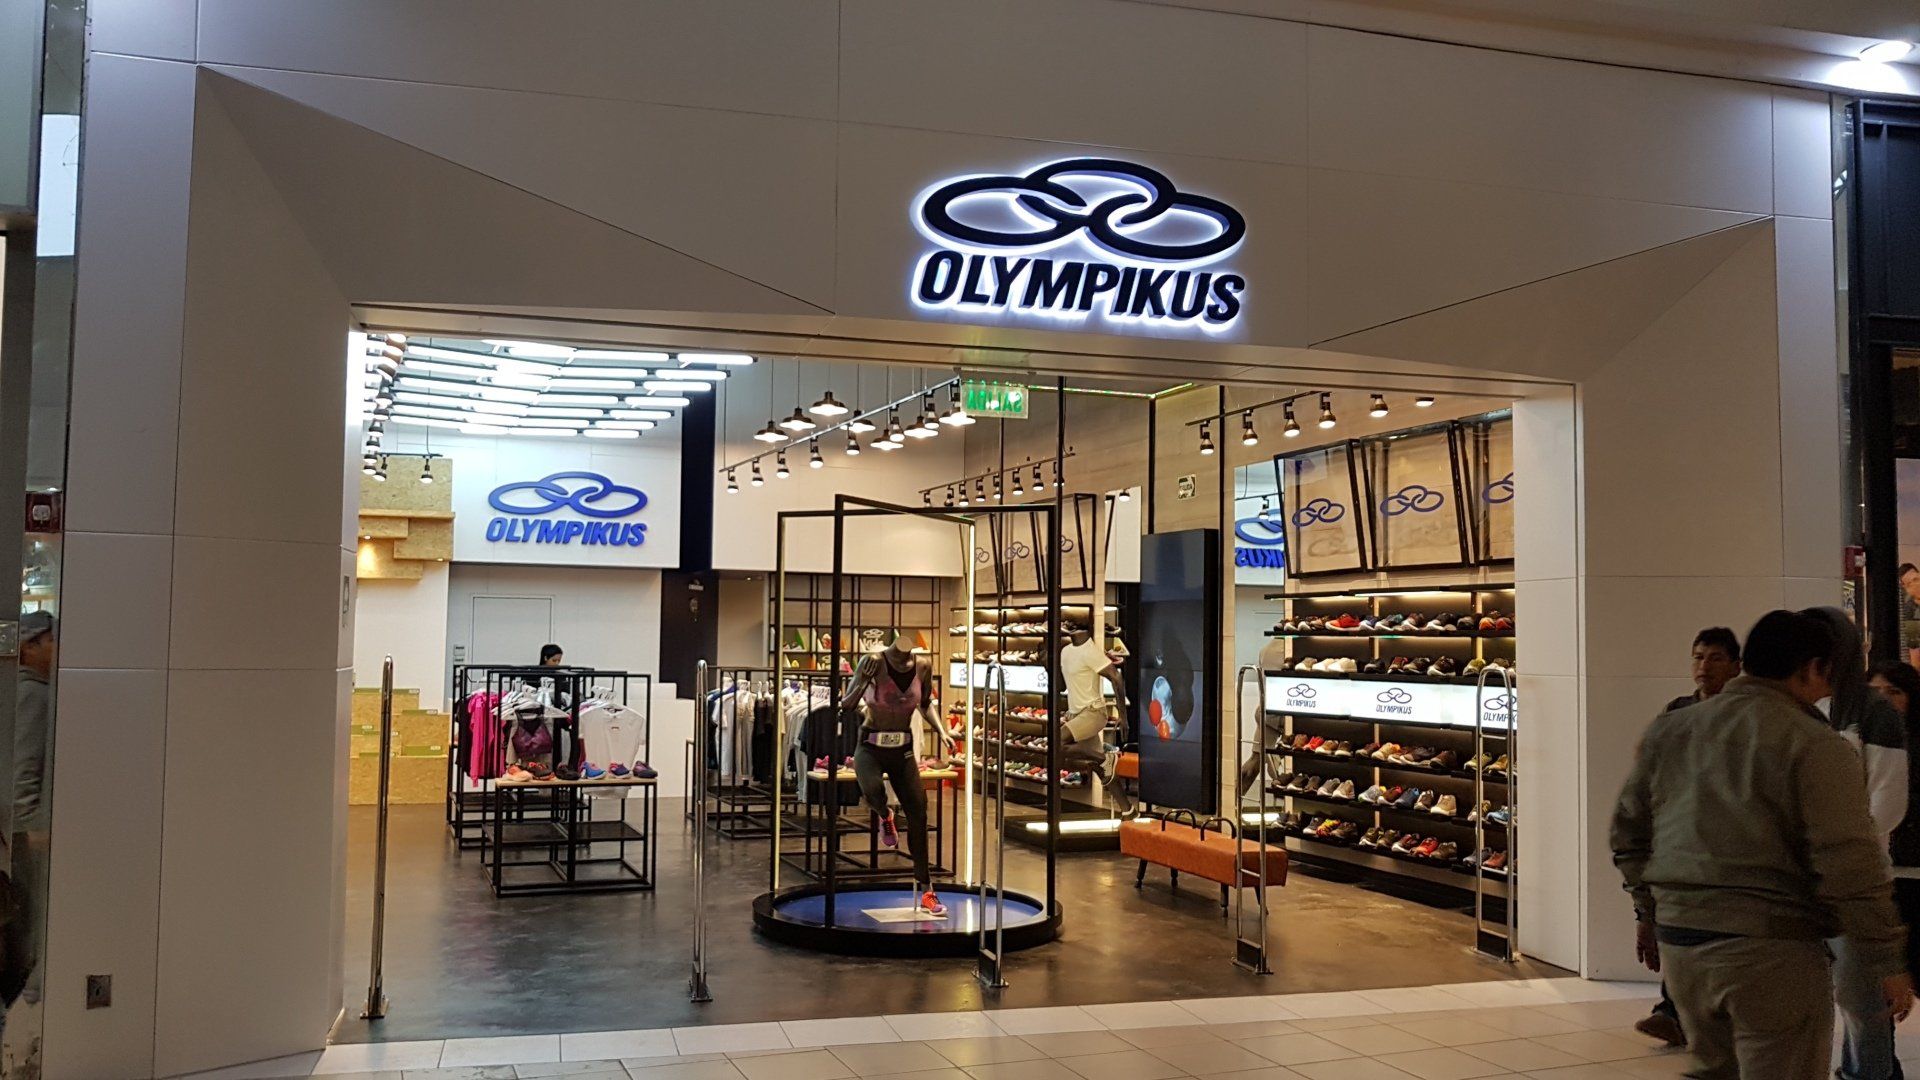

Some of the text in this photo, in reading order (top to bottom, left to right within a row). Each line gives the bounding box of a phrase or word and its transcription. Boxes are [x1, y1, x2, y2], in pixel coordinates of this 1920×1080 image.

[918, 250, 1246, 322] OLYMPIKUS
[486, 516, 648, 547] OLYMPIKUS
[1376, 704, 1412, 715] OLYMPIKUS
[1483, 711, 1517, 723] OLYMPK
